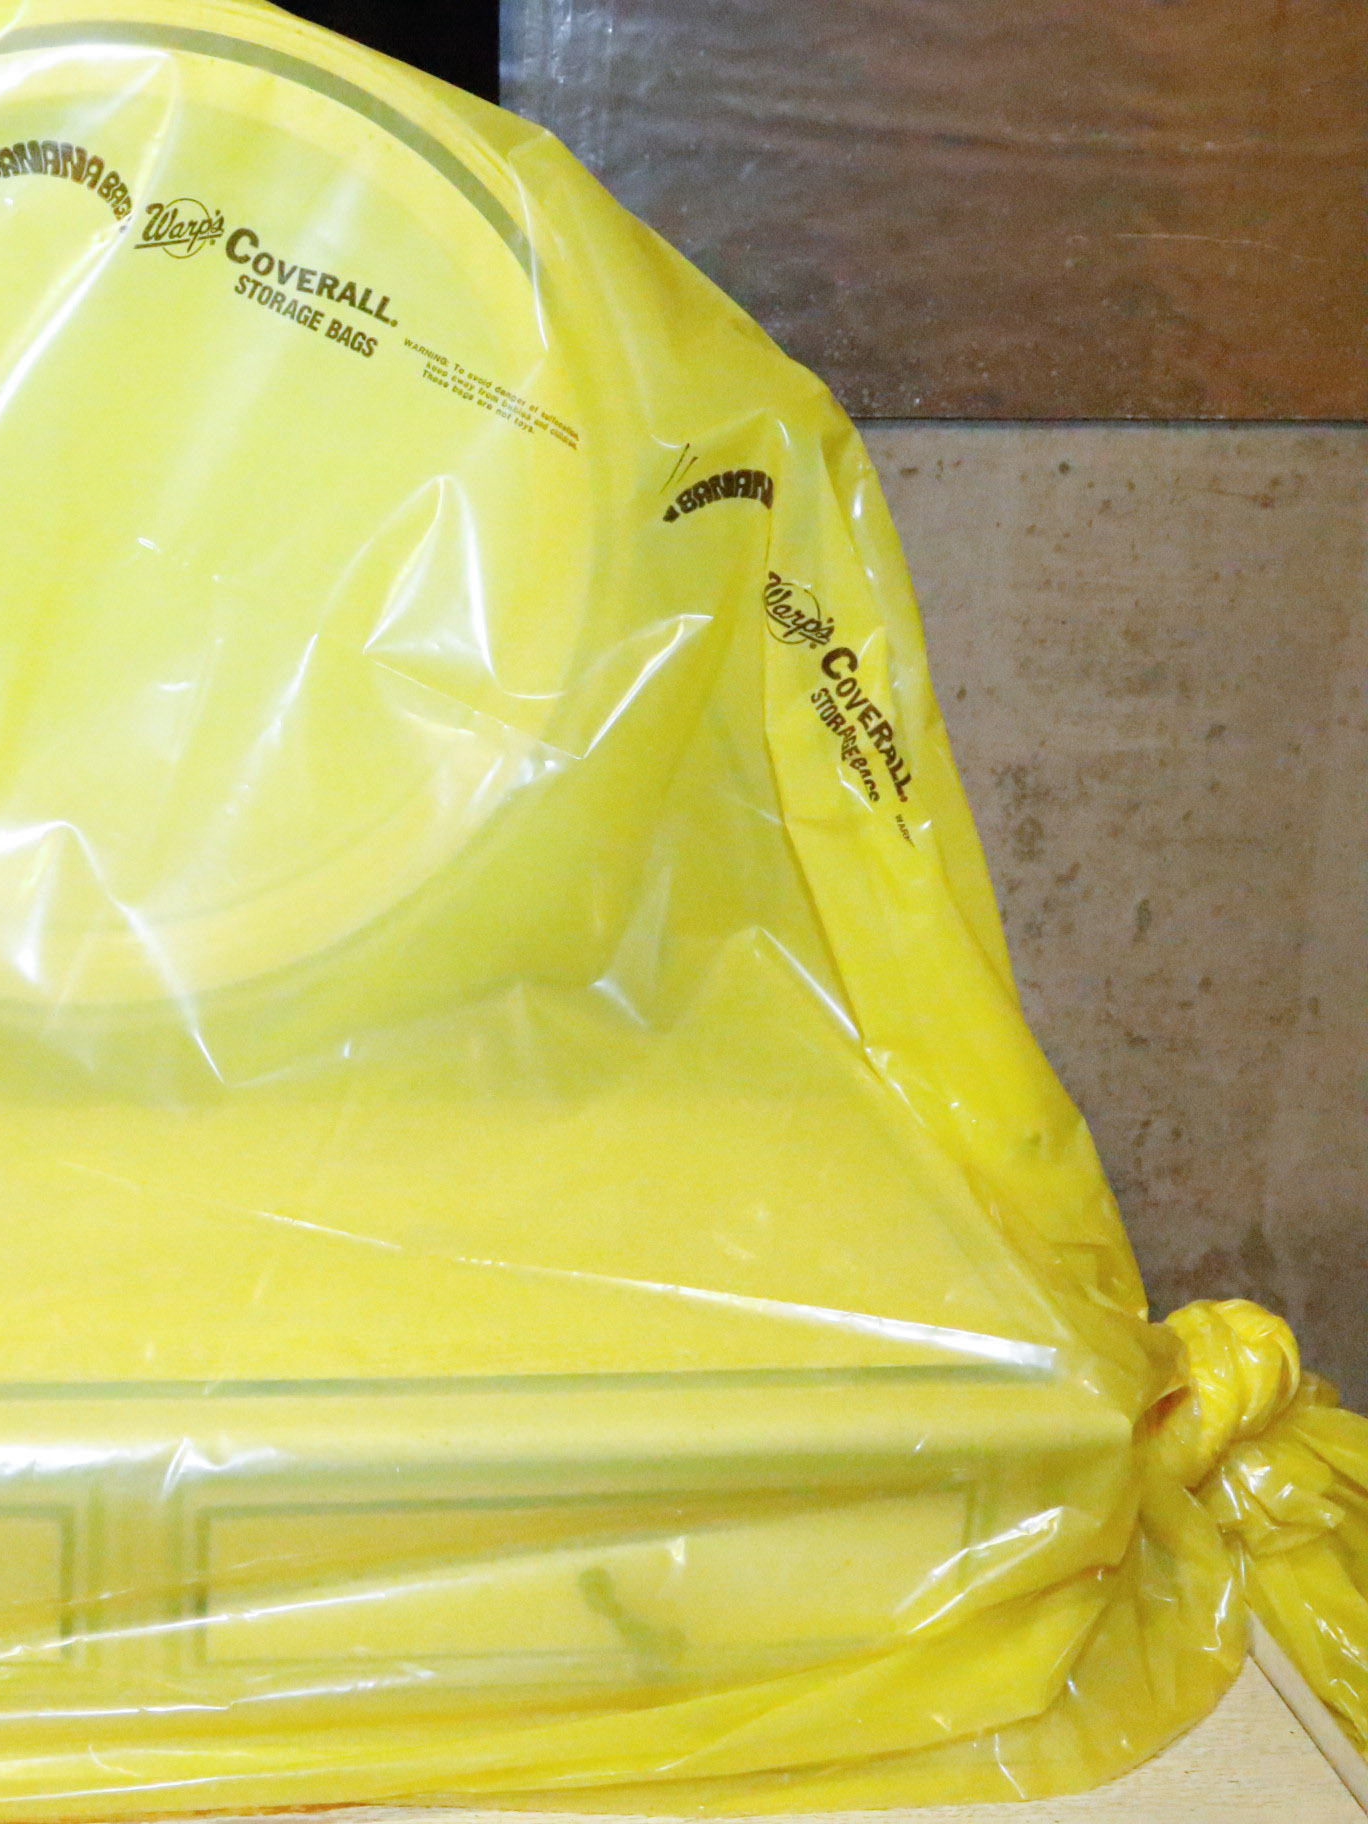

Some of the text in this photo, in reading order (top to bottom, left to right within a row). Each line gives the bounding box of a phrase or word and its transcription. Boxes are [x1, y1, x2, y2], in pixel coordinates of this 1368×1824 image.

[136, 203, 225, 253] Warp's
[234, 275, 379, 358] STORAGE BAGS
[403, 338, 449, 367] WARNING:
[454, 363, 465, 375] To
[467, 372, 492, 388] avoid
[495, 386, 526, 406] danger
[529, 405, 539, 413] of
[422, 369, 449, 388] These
[452, 385, 474, 401] bags
[477, 398, 492, 410] are
[495, 408, 511, 420] not
[425, 361, 449, 377] keep
[451, 375, 474, 391] away
[477, 387, 499, 403] from
[501, 399, 531, 420] babies
[533, 418, 549, 431] and
[675, 469, 774, 514] BANAN
[764, 571, 835, 646] Warp's
[811, 687, 861, 762] STORAGE
